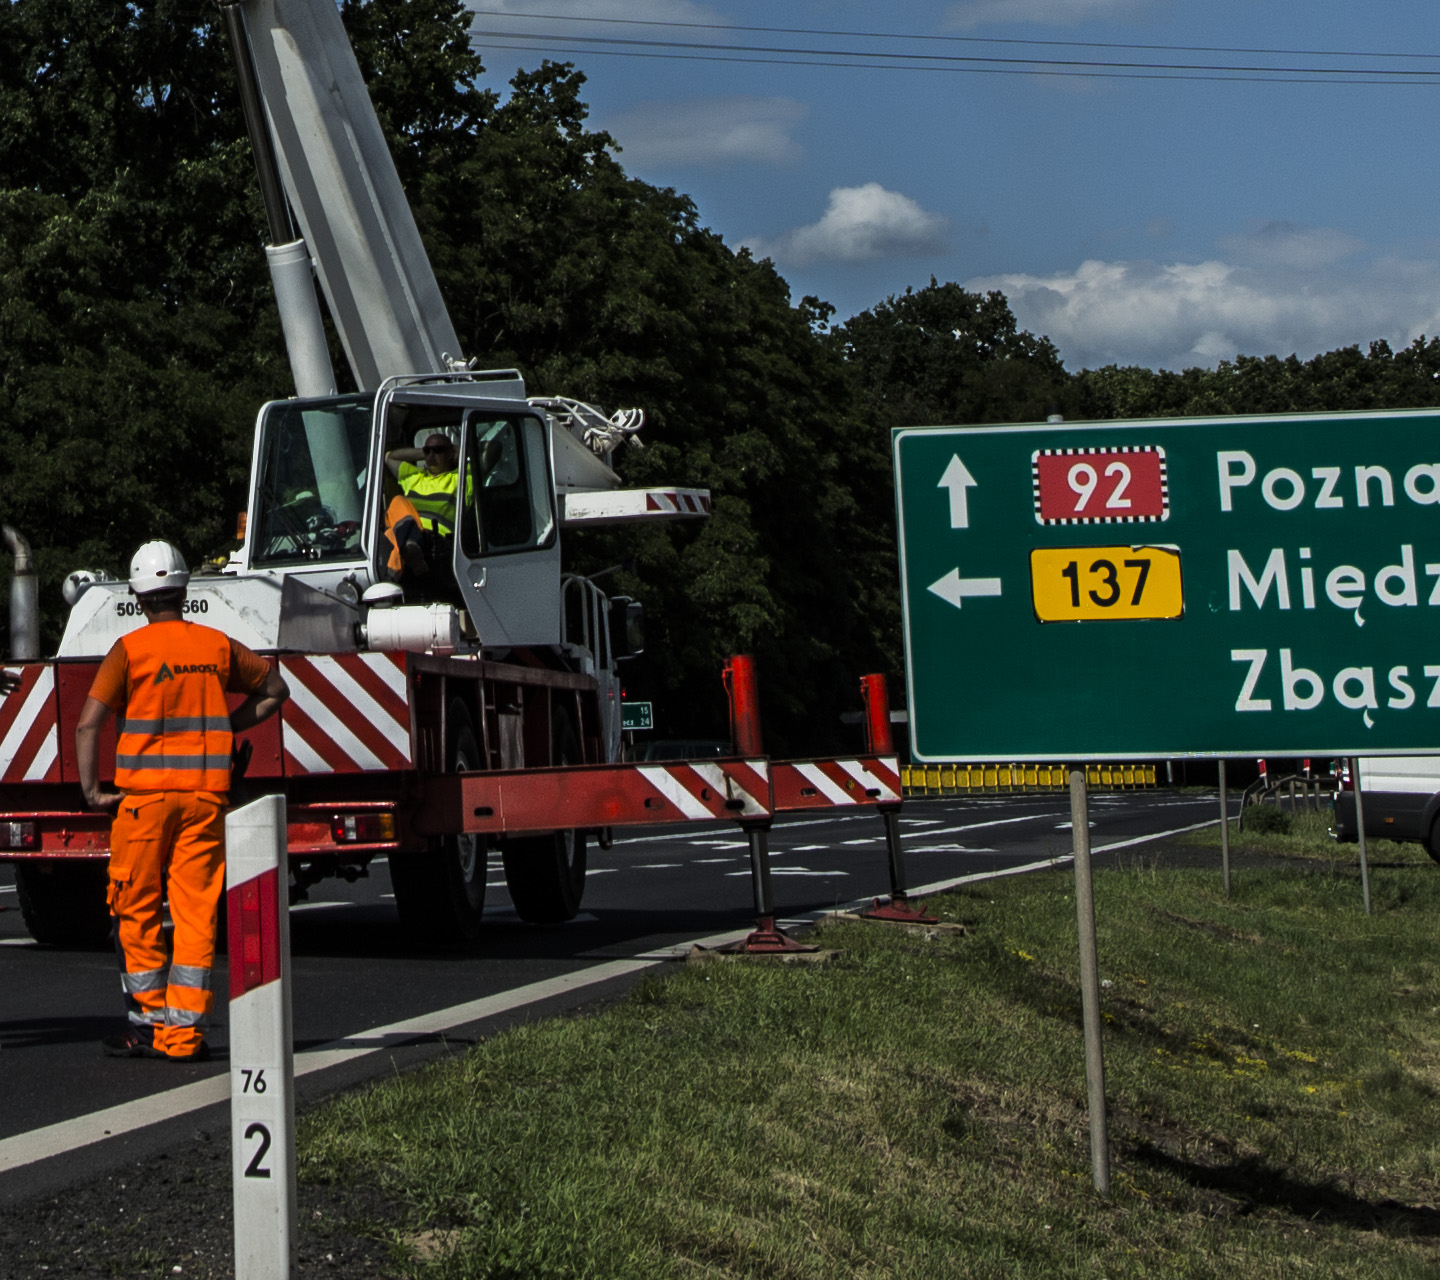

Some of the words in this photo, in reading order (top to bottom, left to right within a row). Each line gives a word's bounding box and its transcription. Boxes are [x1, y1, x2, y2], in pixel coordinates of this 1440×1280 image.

[1068, 462, 1133, 512] 92
[1061, 559, 1152, 609] 137
[173, 664, 218, 676] BAROSZ
[241, 1069, 267, 1094] 76
[244, 1122, 271, 1178] 2
